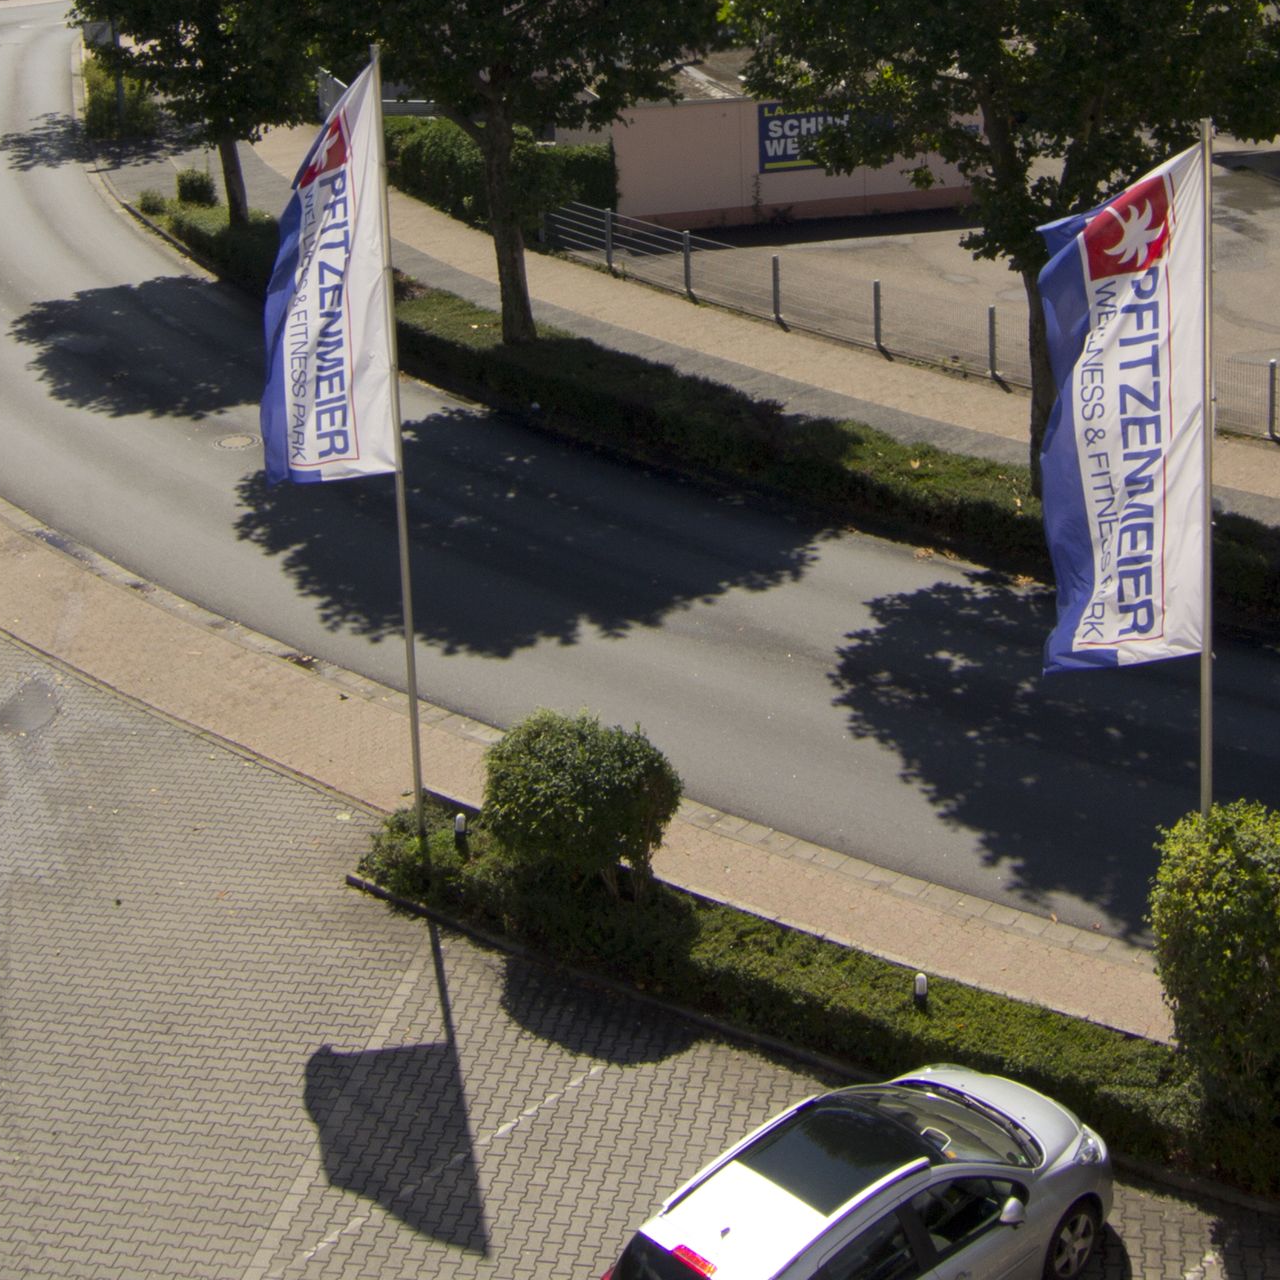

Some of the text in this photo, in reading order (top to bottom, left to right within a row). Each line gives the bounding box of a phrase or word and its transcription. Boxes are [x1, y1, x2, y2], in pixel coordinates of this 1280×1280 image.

[290, 309, 308, 398] FITNESS
[315, 169, 350, 460] PFITZENMEIER
[291, 402, 307, 460] PARK
[1083, 427, 1106, 448] &
[1117, 266, 1162, 637] PFITZENMEIER
